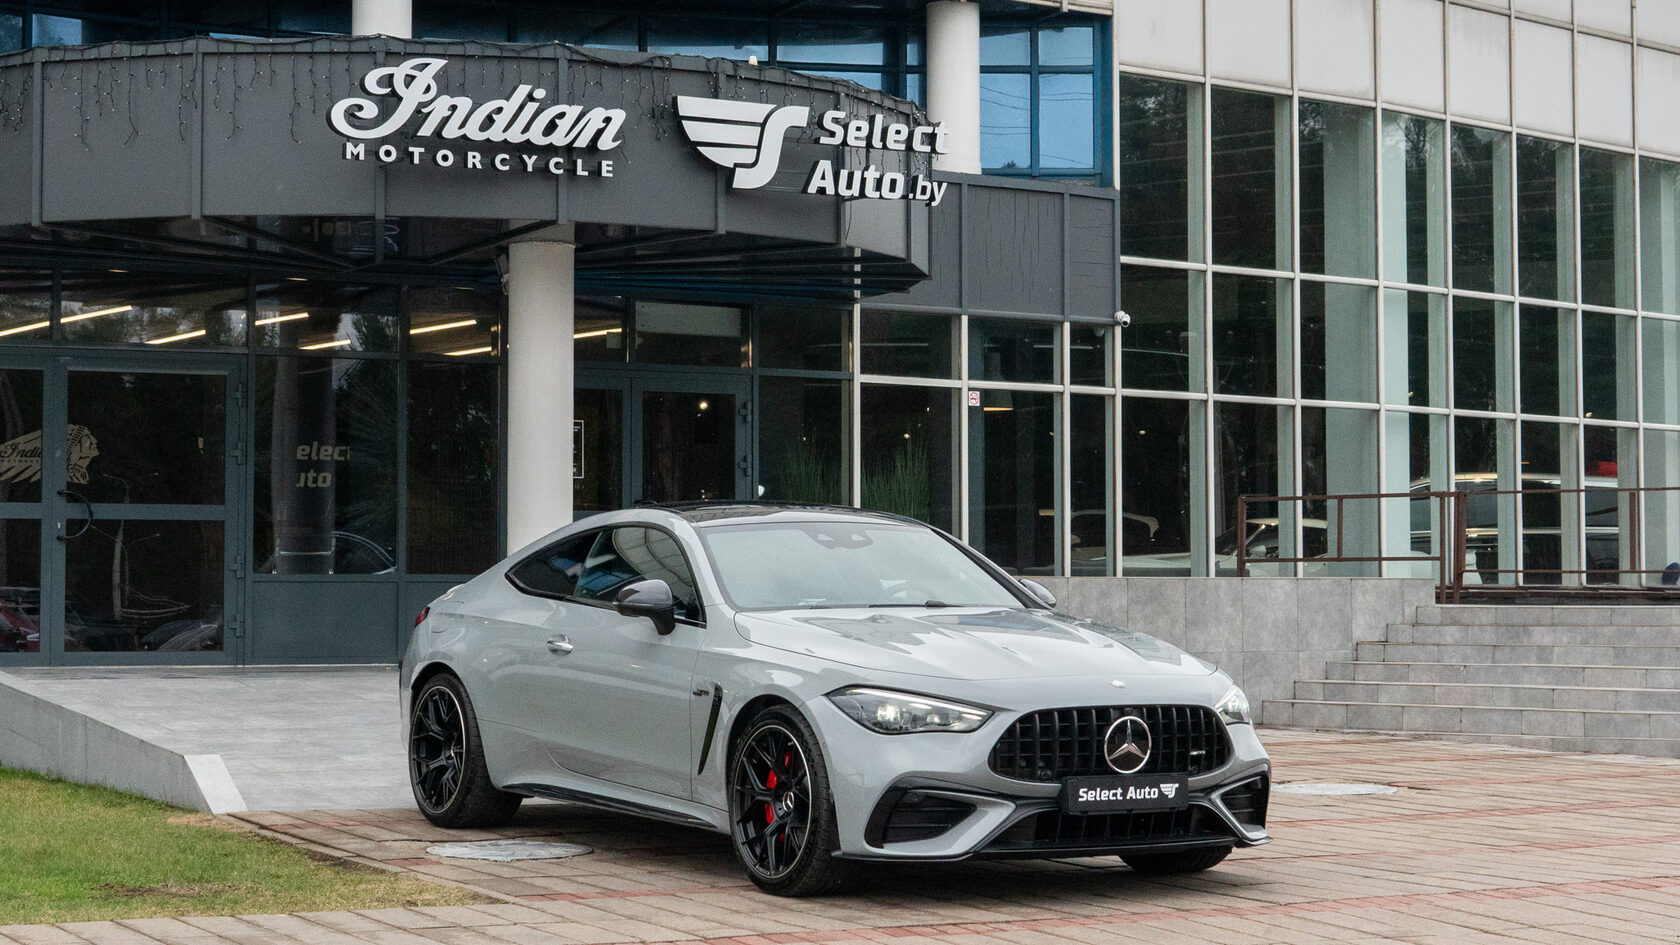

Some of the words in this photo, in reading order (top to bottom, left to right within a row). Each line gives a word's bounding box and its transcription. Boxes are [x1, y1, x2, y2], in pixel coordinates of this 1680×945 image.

[330, 57, 627, 151] Indian
[819, 110, 949, 155] Select
[345, 141, 614, 178] MOTORCYCLE
[807, 159, 948, 206] Auto.by
[296, 440, 351, 461] elec
[1078, 787, 1123, 802] Select
[1126, 786, 1159, 800] Auto
